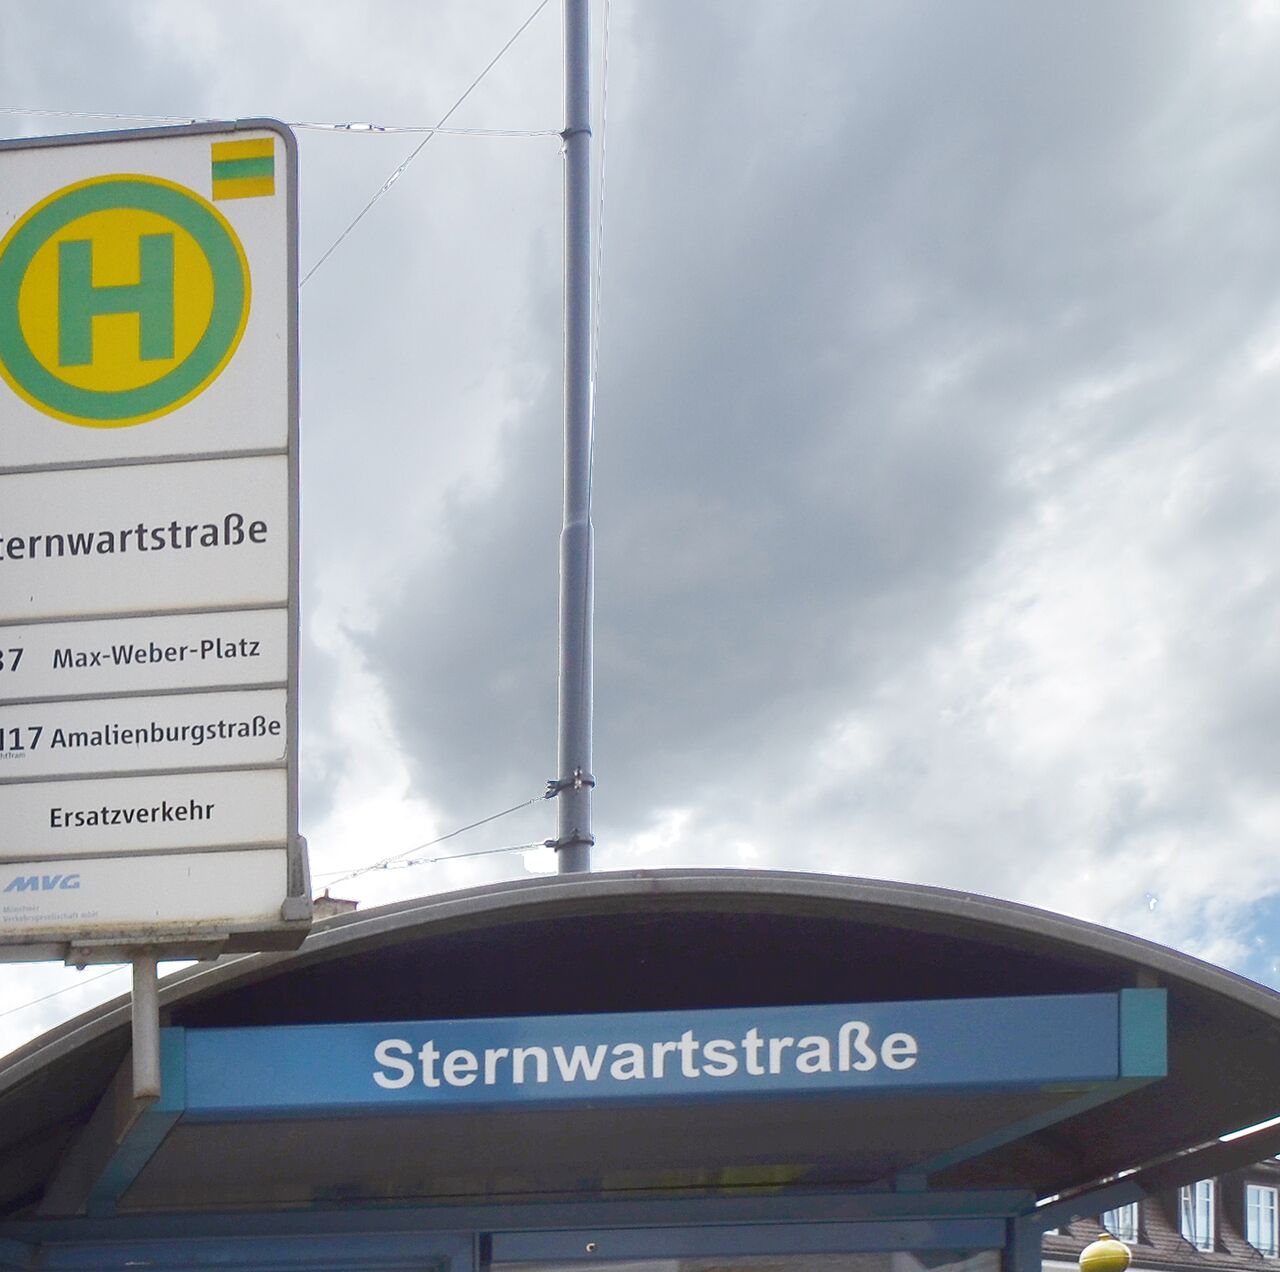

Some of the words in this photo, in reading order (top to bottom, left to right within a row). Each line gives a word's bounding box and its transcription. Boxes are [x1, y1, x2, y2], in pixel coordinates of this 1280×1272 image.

[58, 232, 175, 367] H
[52, 638, 261, 670] Max-Weber-Platz
[50, 715, 282, 749] Amalienburgstraße
[49, 799, 215, 828] Ersatzverkehr
[2, 874, 81, 892] MVG
[373, 1020, 920, 1089] Sternwartstraße
